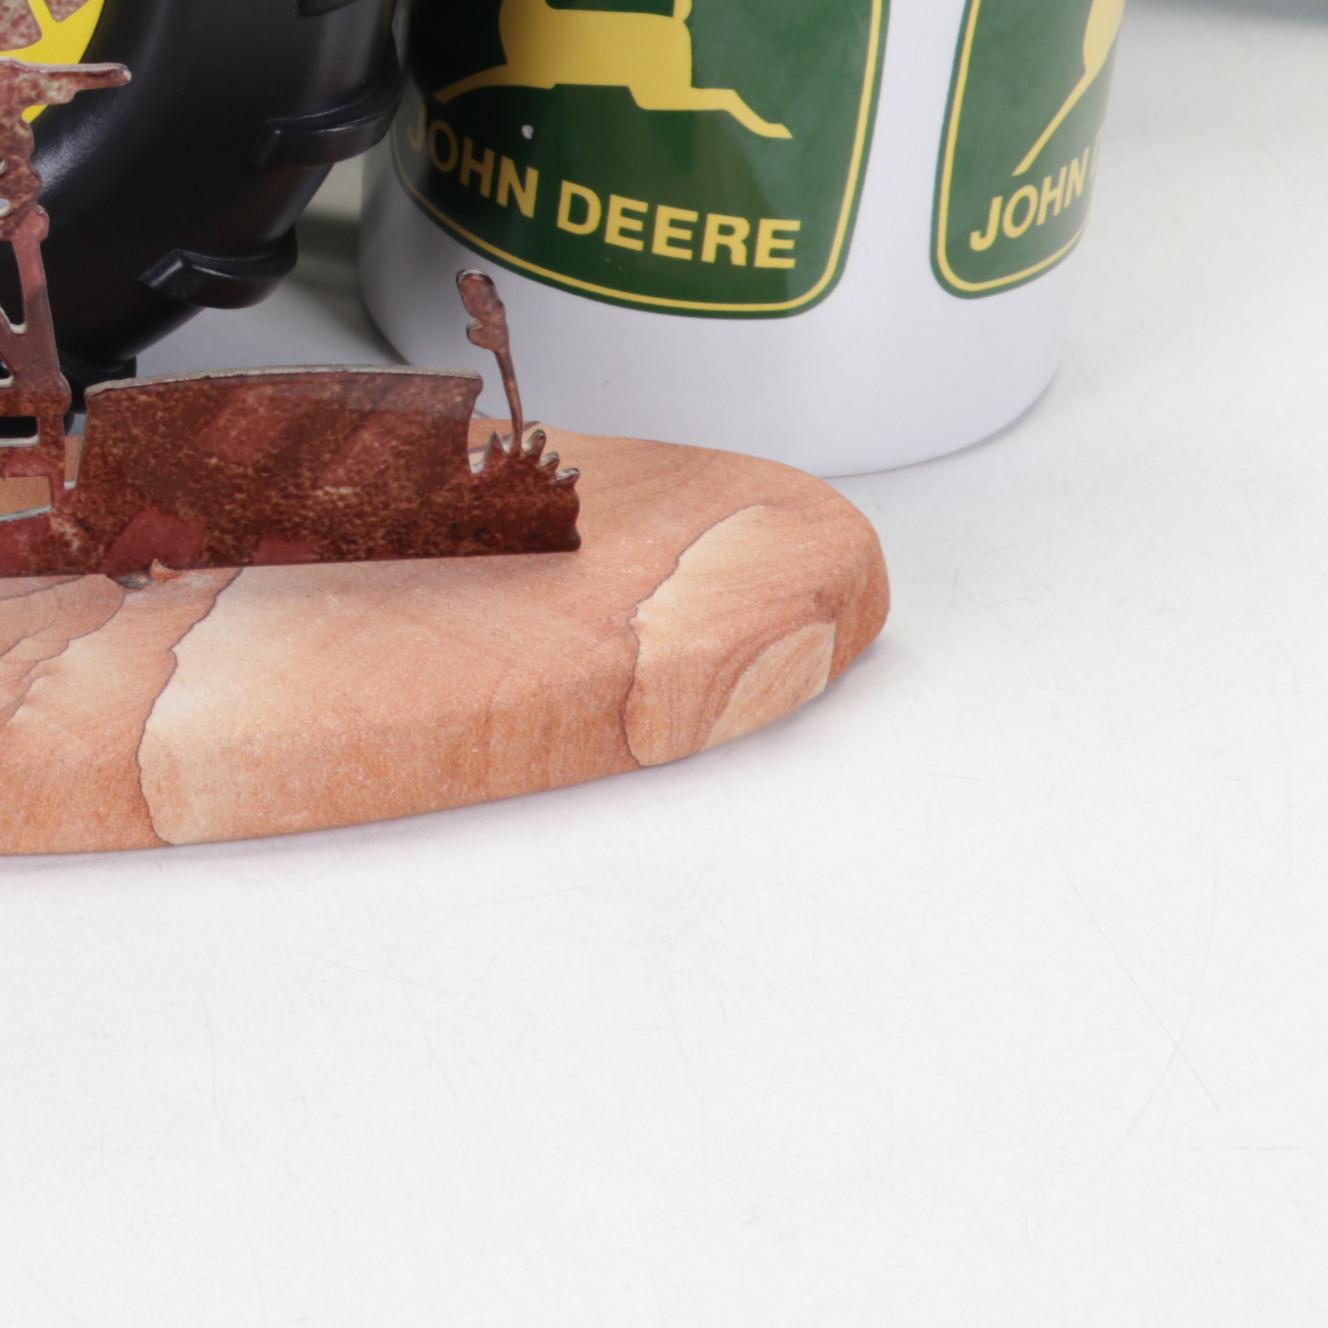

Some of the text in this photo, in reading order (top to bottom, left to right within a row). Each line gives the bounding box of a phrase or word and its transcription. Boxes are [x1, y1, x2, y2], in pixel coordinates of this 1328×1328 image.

[407, 103, 802, 269] JOHN DEERE
[969, 147, 1091, 252] JOHN
